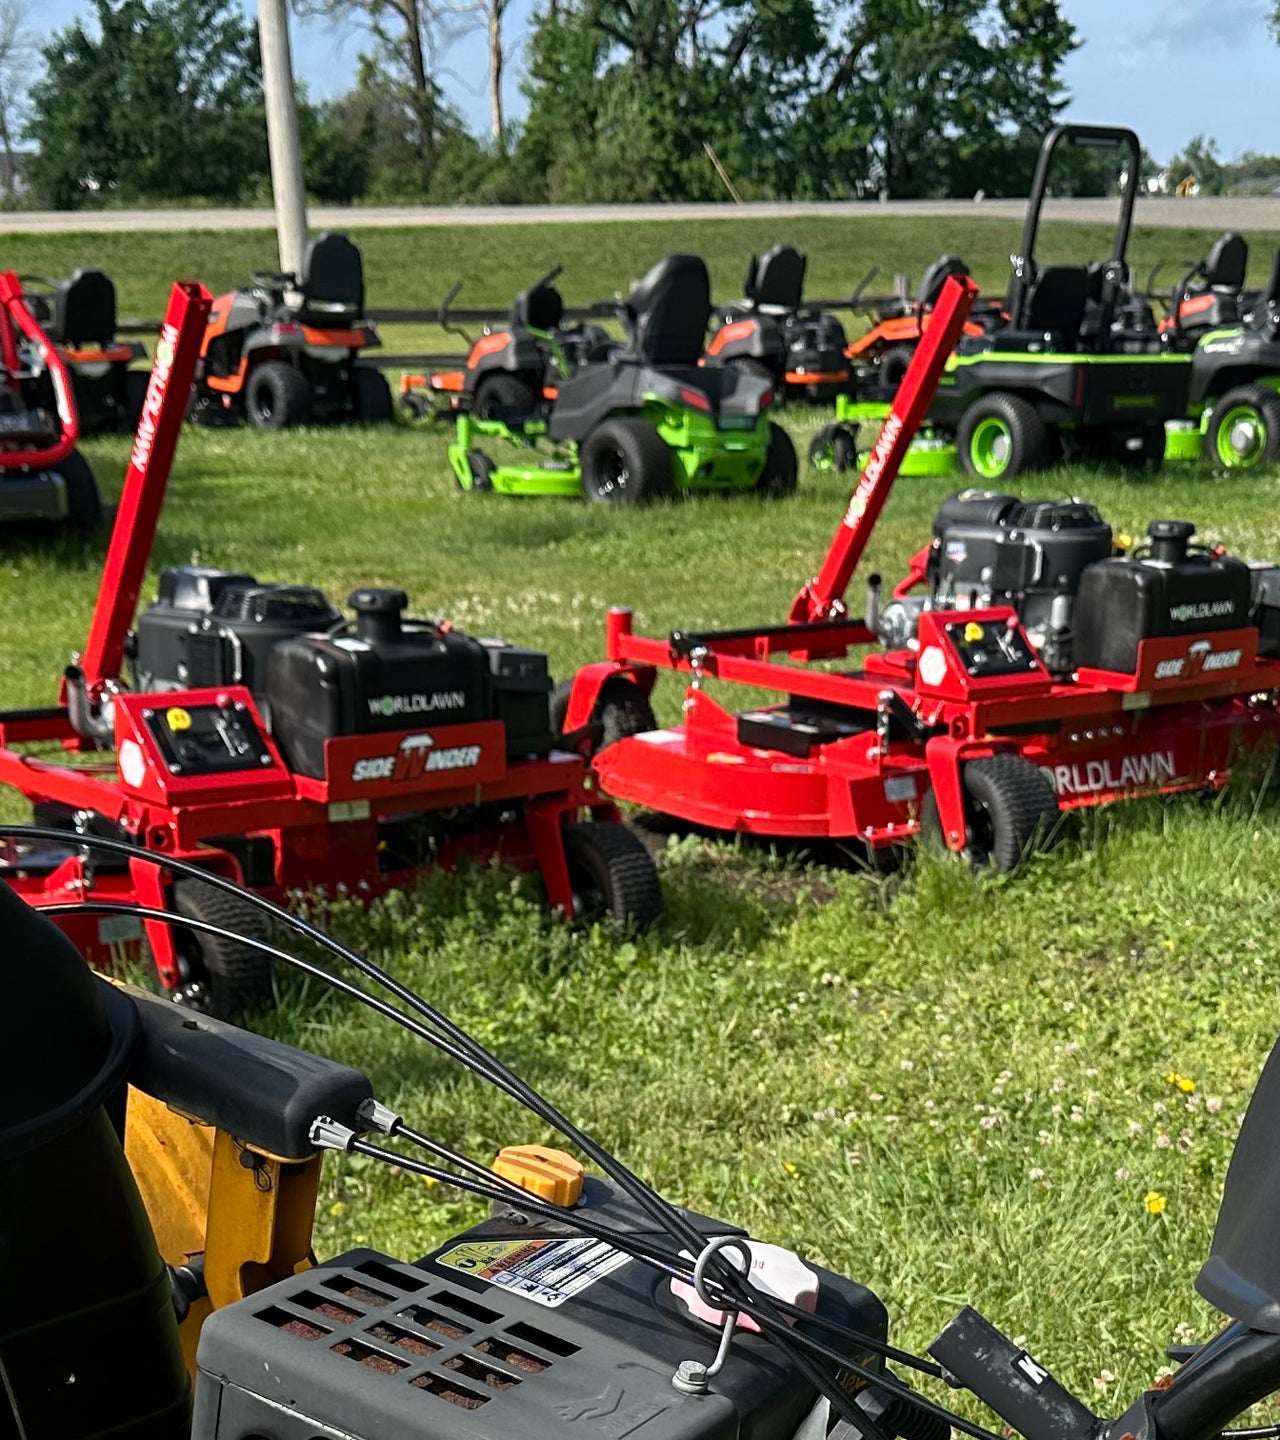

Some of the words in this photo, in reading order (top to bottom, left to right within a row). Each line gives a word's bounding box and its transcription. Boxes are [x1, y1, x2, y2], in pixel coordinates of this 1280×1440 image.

[1169, 600, 1235, 621] WORLDLAWN
[368, 690, 466, 716] WORLDLAWN
[1038, 750, 1176, 796] RLDLAWN
